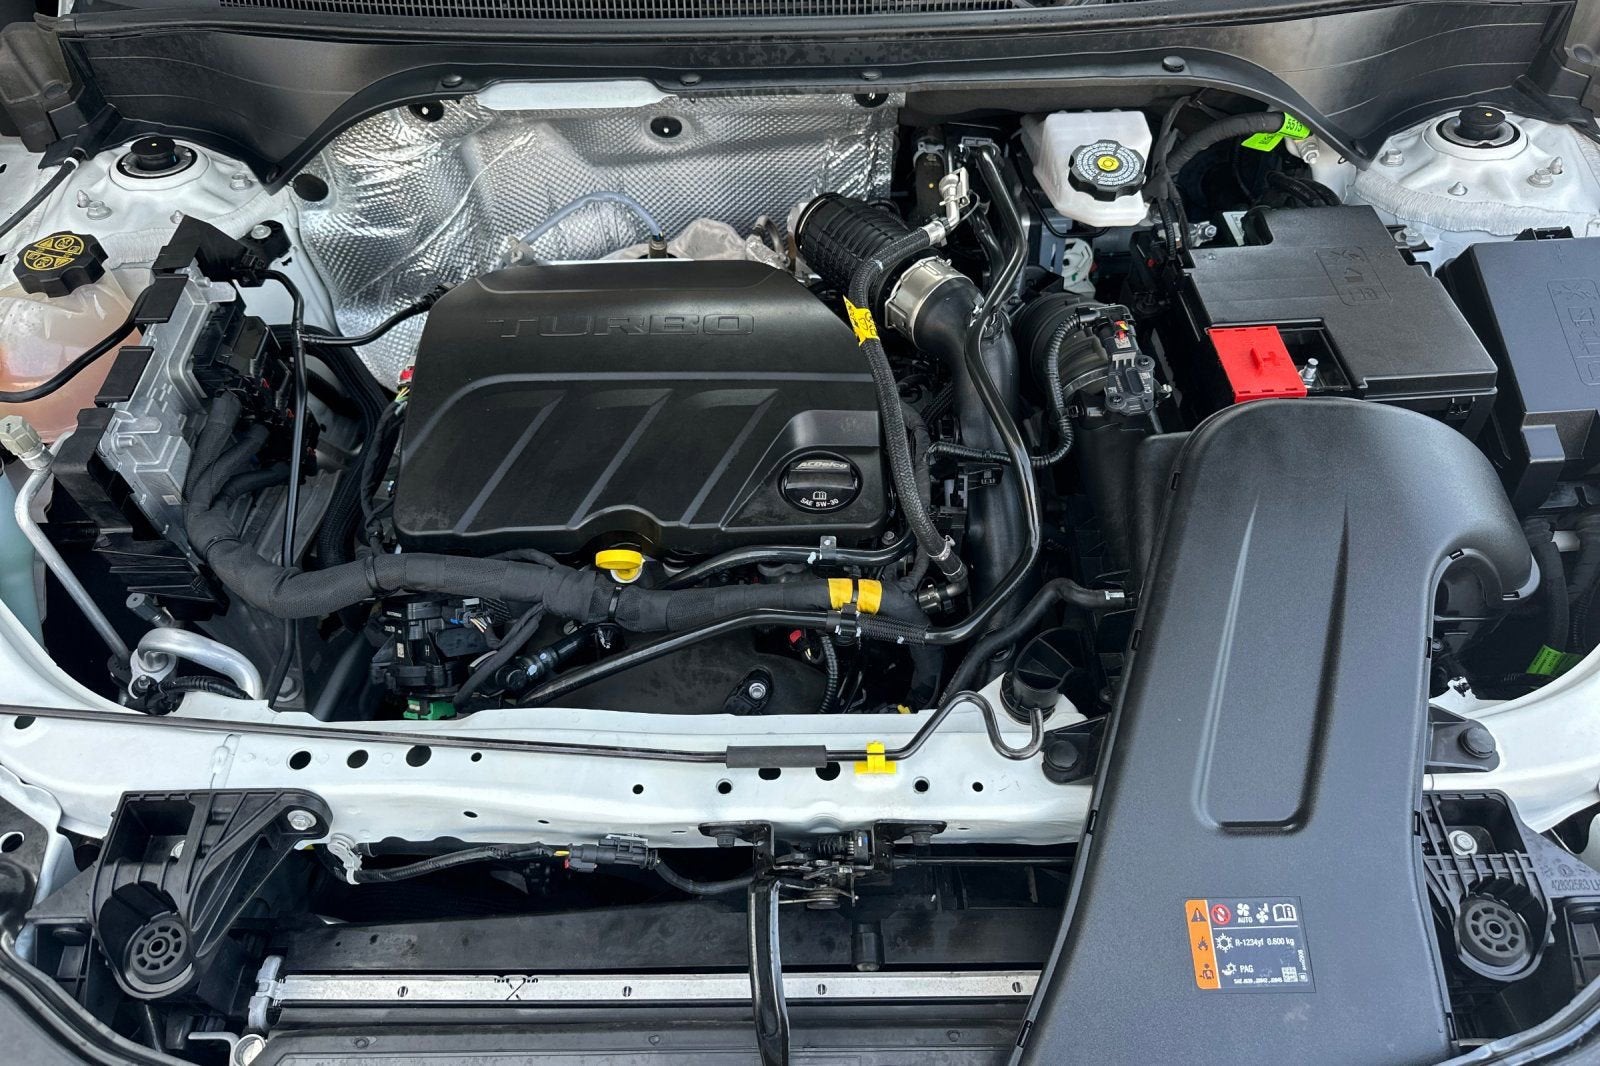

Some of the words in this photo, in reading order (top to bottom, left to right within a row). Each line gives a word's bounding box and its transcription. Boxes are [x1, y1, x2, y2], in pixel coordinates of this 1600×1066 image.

[486, 313, 754, 338] TURBO
[795, 461, 848, 470] ACDelco
[800, 497, 814, 506] SAE
[815, 498, 839, 507] 5W-30
[1286, 937, 1295, 946] kg
[1240, 965, 1254, 973] PAG
